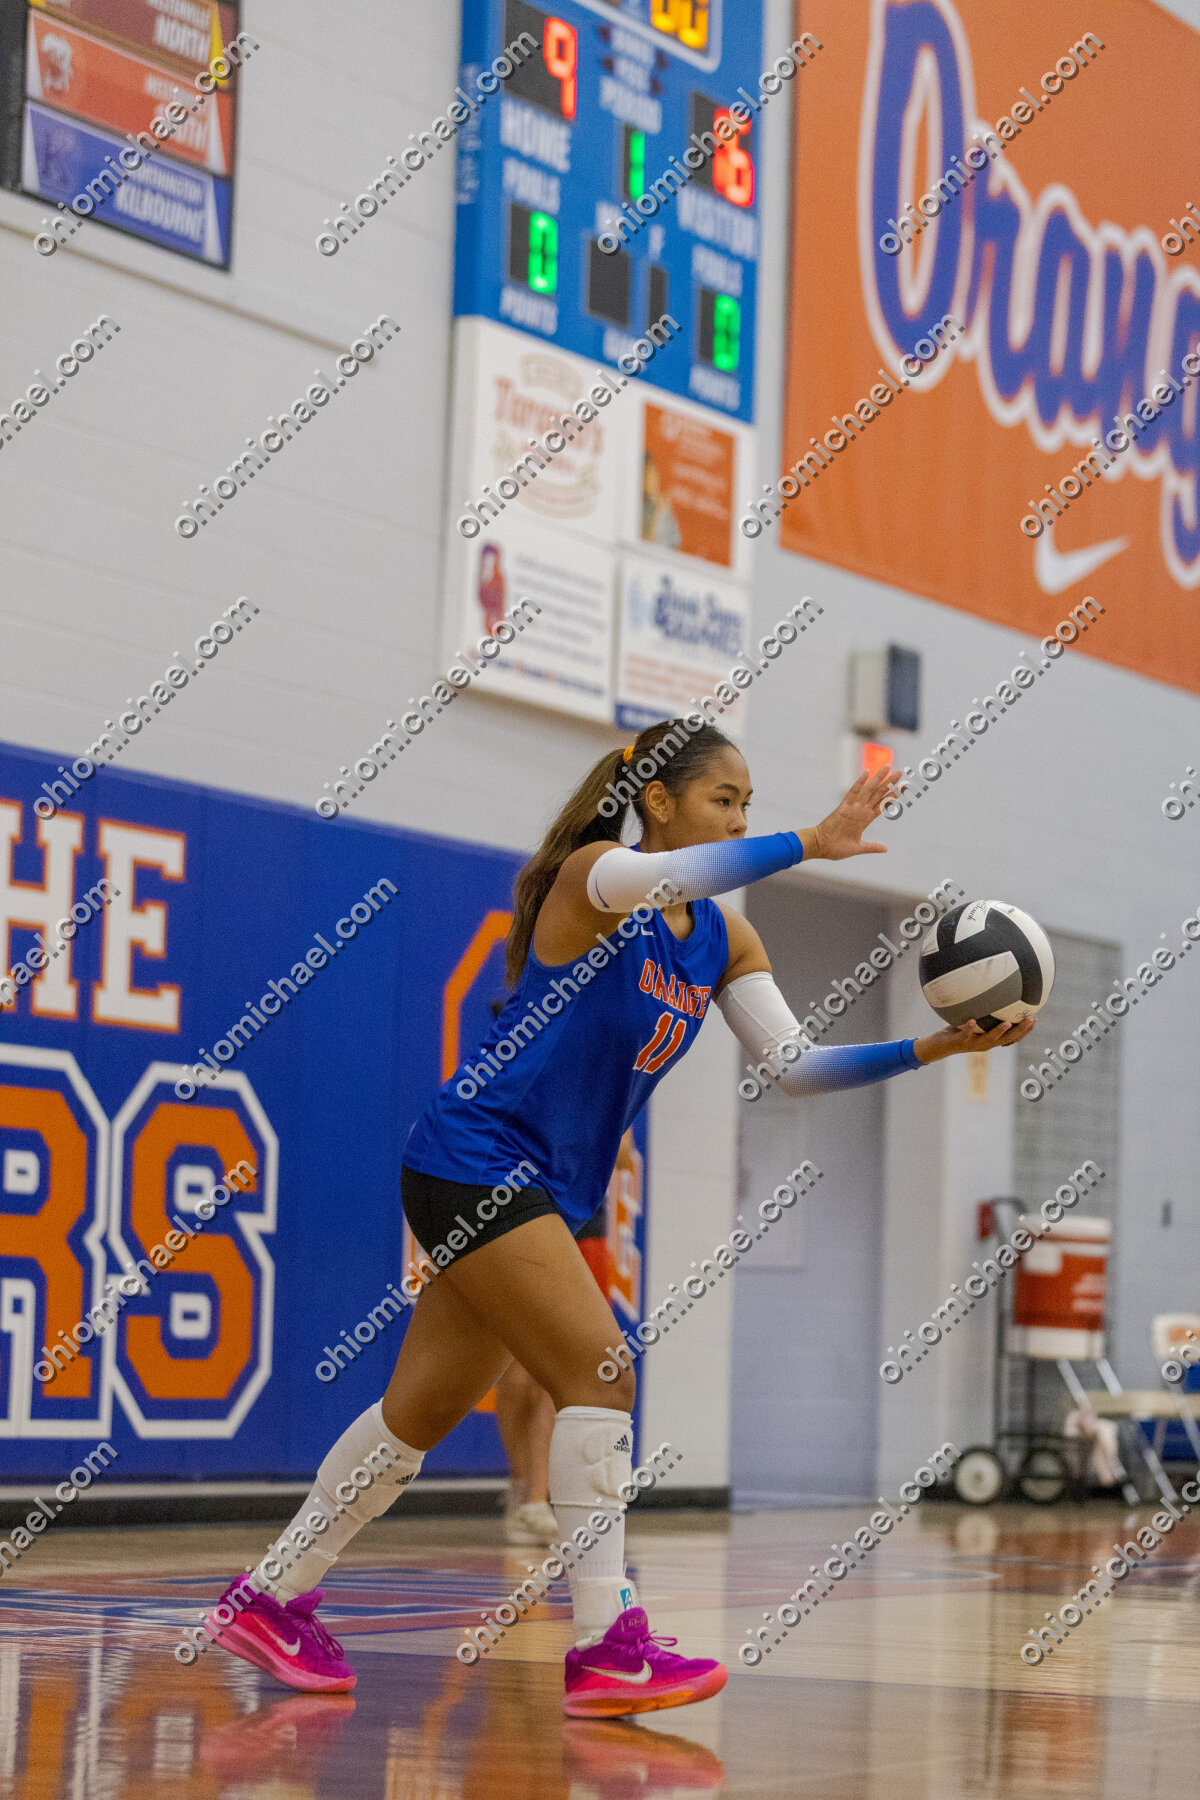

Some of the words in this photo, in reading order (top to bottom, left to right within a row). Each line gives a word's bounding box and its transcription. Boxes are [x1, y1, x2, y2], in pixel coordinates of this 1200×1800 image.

[543, 16, 577, 119] 9
[528, 211, 558, 294] 0
[632, 1011, 687, 1074] 11
